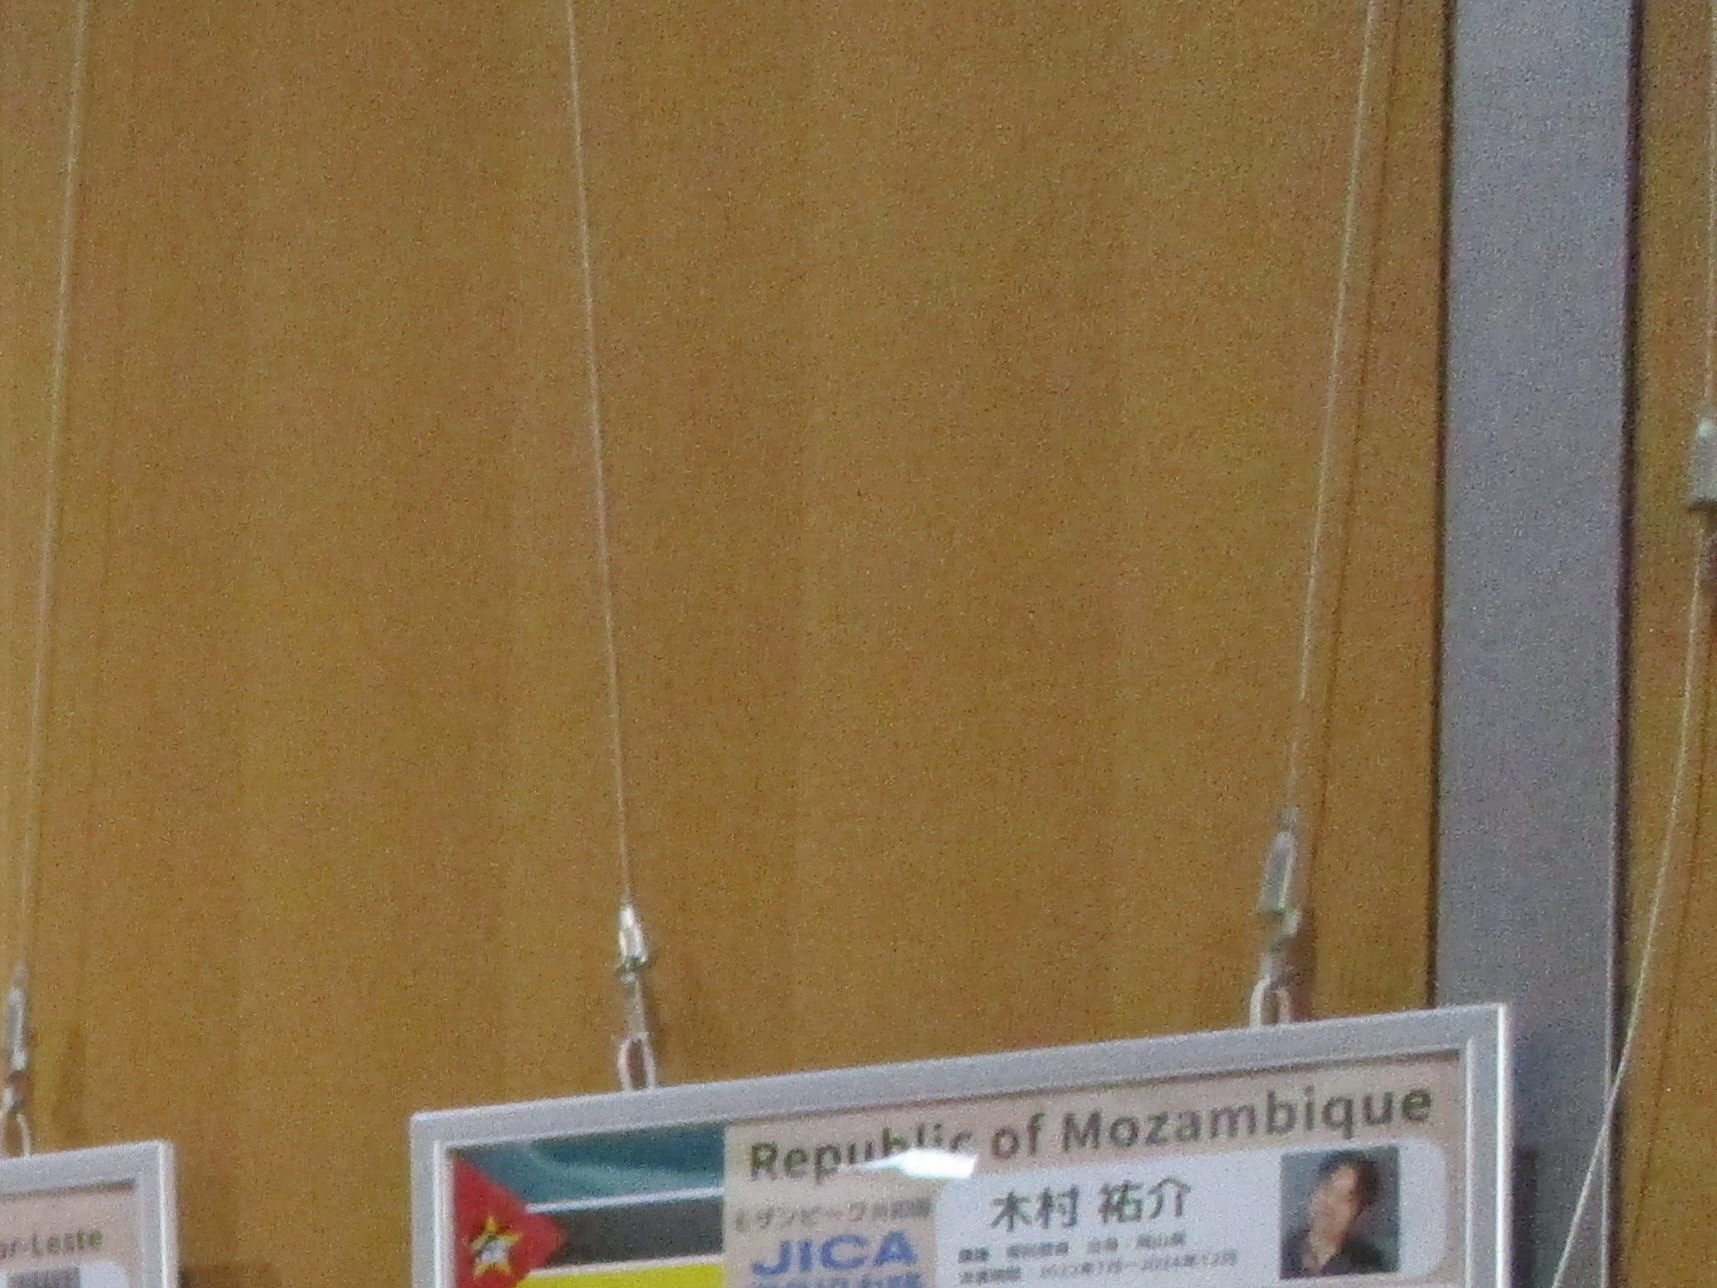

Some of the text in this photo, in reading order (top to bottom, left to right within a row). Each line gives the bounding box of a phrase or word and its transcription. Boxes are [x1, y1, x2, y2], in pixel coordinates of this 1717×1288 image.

[750, 1083, 1433, 1184] Republic of Mozambique
[989, 1184, 1081, 1233] 木村
[751, 1230, 918, 1278] JICA
